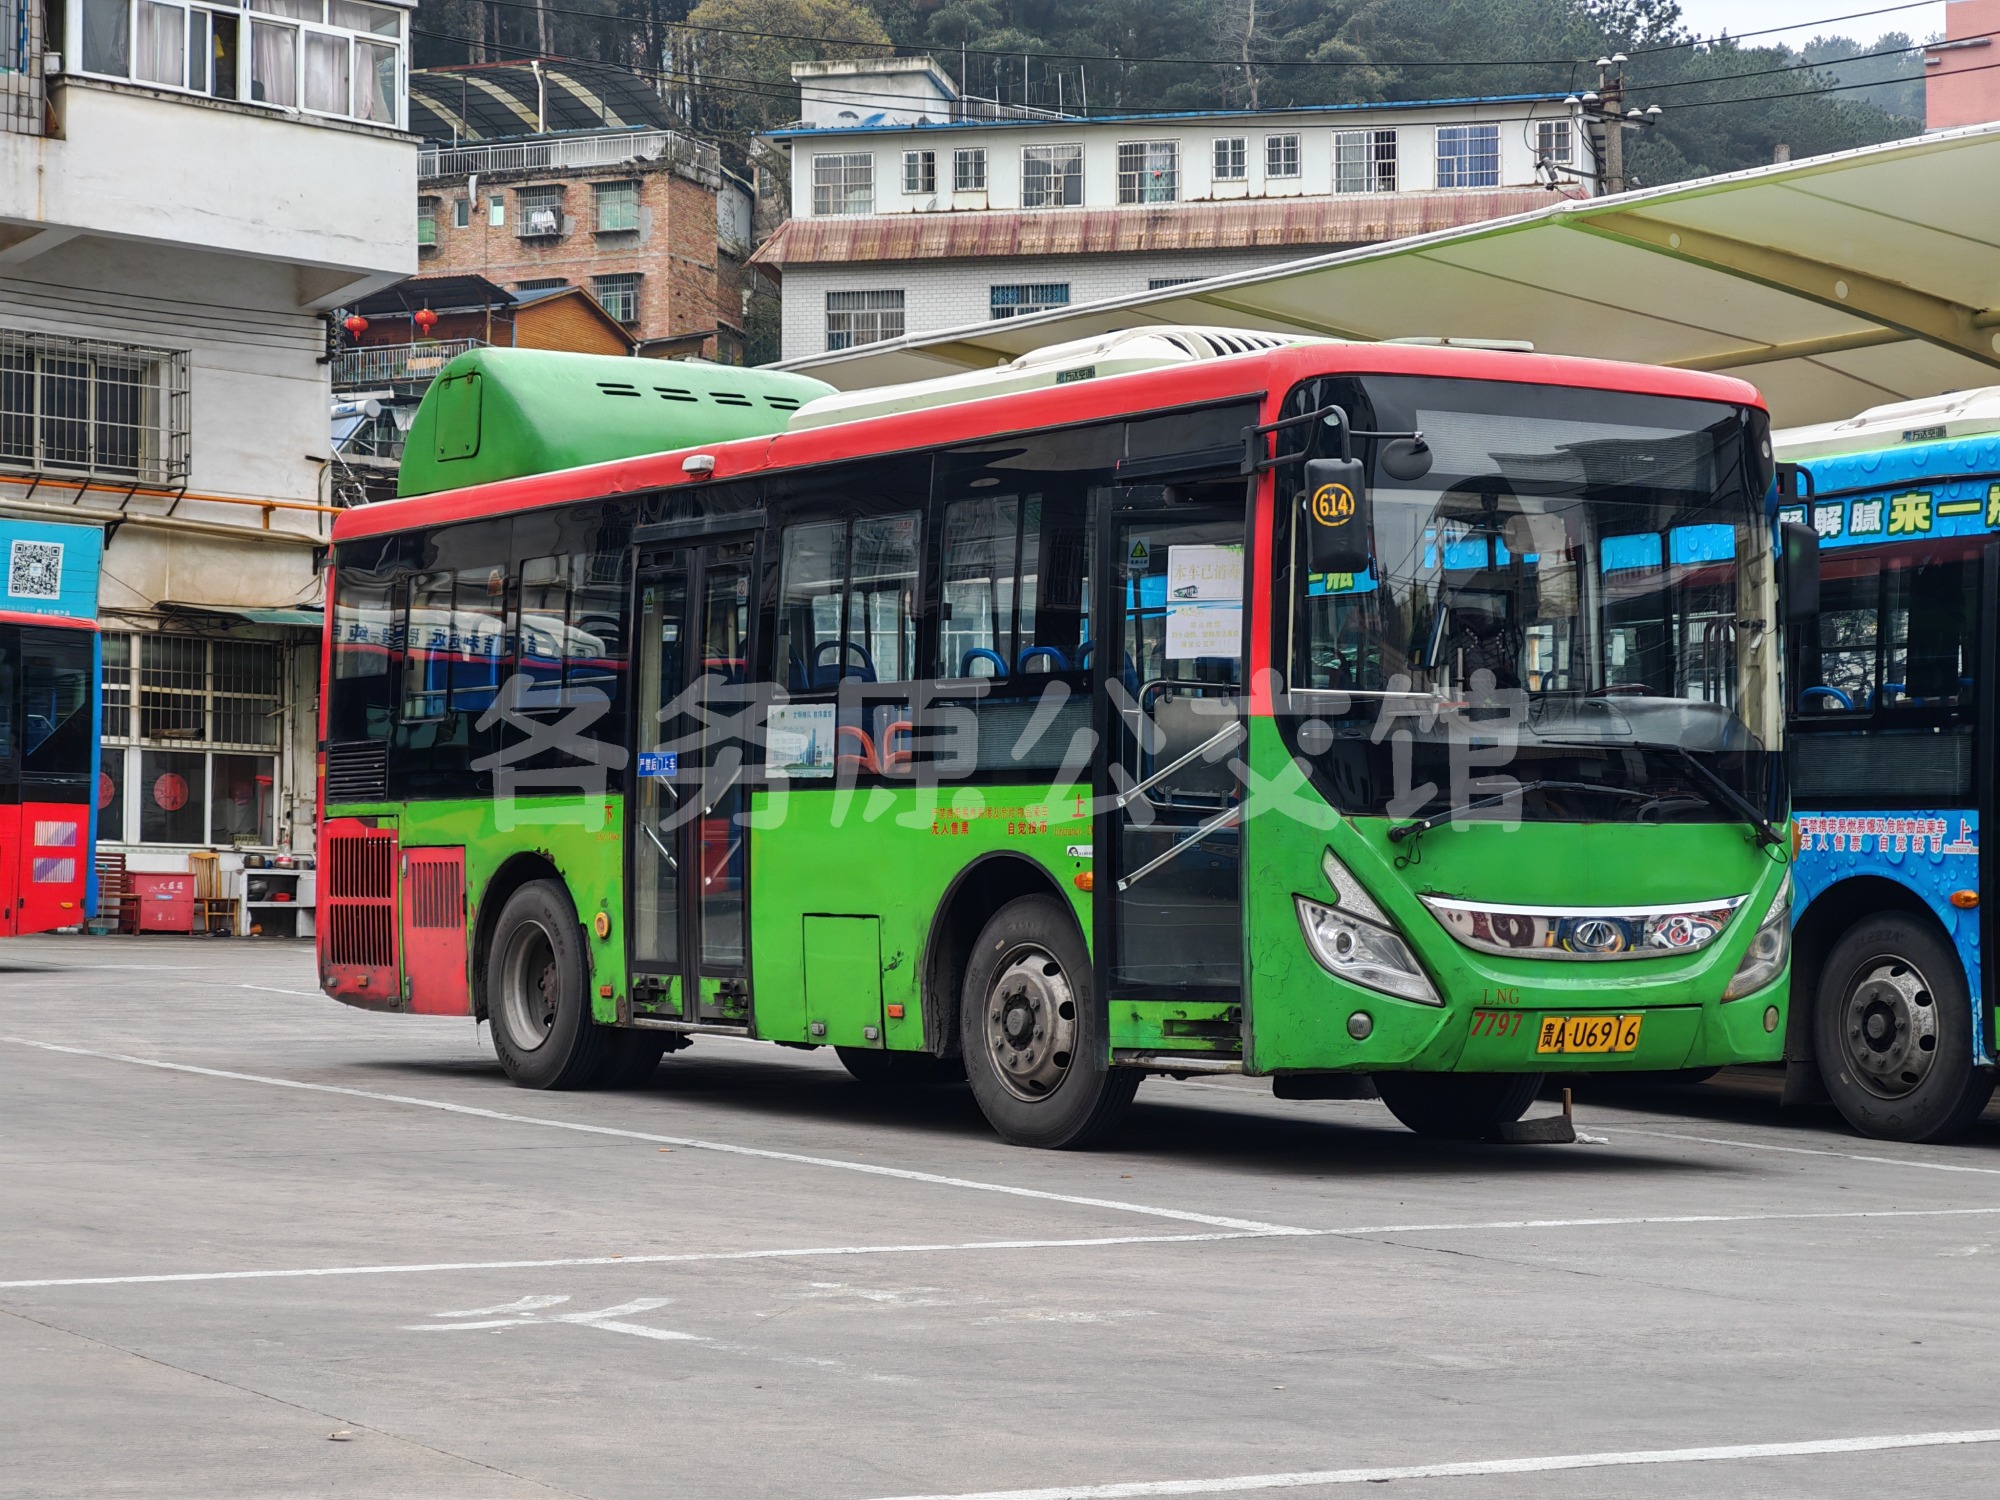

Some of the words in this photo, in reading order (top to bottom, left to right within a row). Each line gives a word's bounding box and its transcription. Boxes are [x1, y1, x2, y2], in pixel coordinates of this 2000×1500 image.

[1911, 426, 1944, 441] 万达空调
[1320, 493, 1349, 517] 614
[639, 757, 676, 771] 严禁后门上车
[604, 805, 614, 825] 下
[1072, 794, 1085, 818] 上
[931, 822, 969, 835] 无人售票
[1007, 820, 1048, 835] 自觉投币
[1799, 818, 1947, 835] 严禁携带易燃易爆及危险物品乘车
[1954, 819, 1972, 845] 上
[1801, 835, 1862, 850] 无人售票
[1879, 836, 1942, 852] 自觉投币
[1482, 988, 1520, 1006] LNG
[1471, 1012, 1523, 1037] 7797
